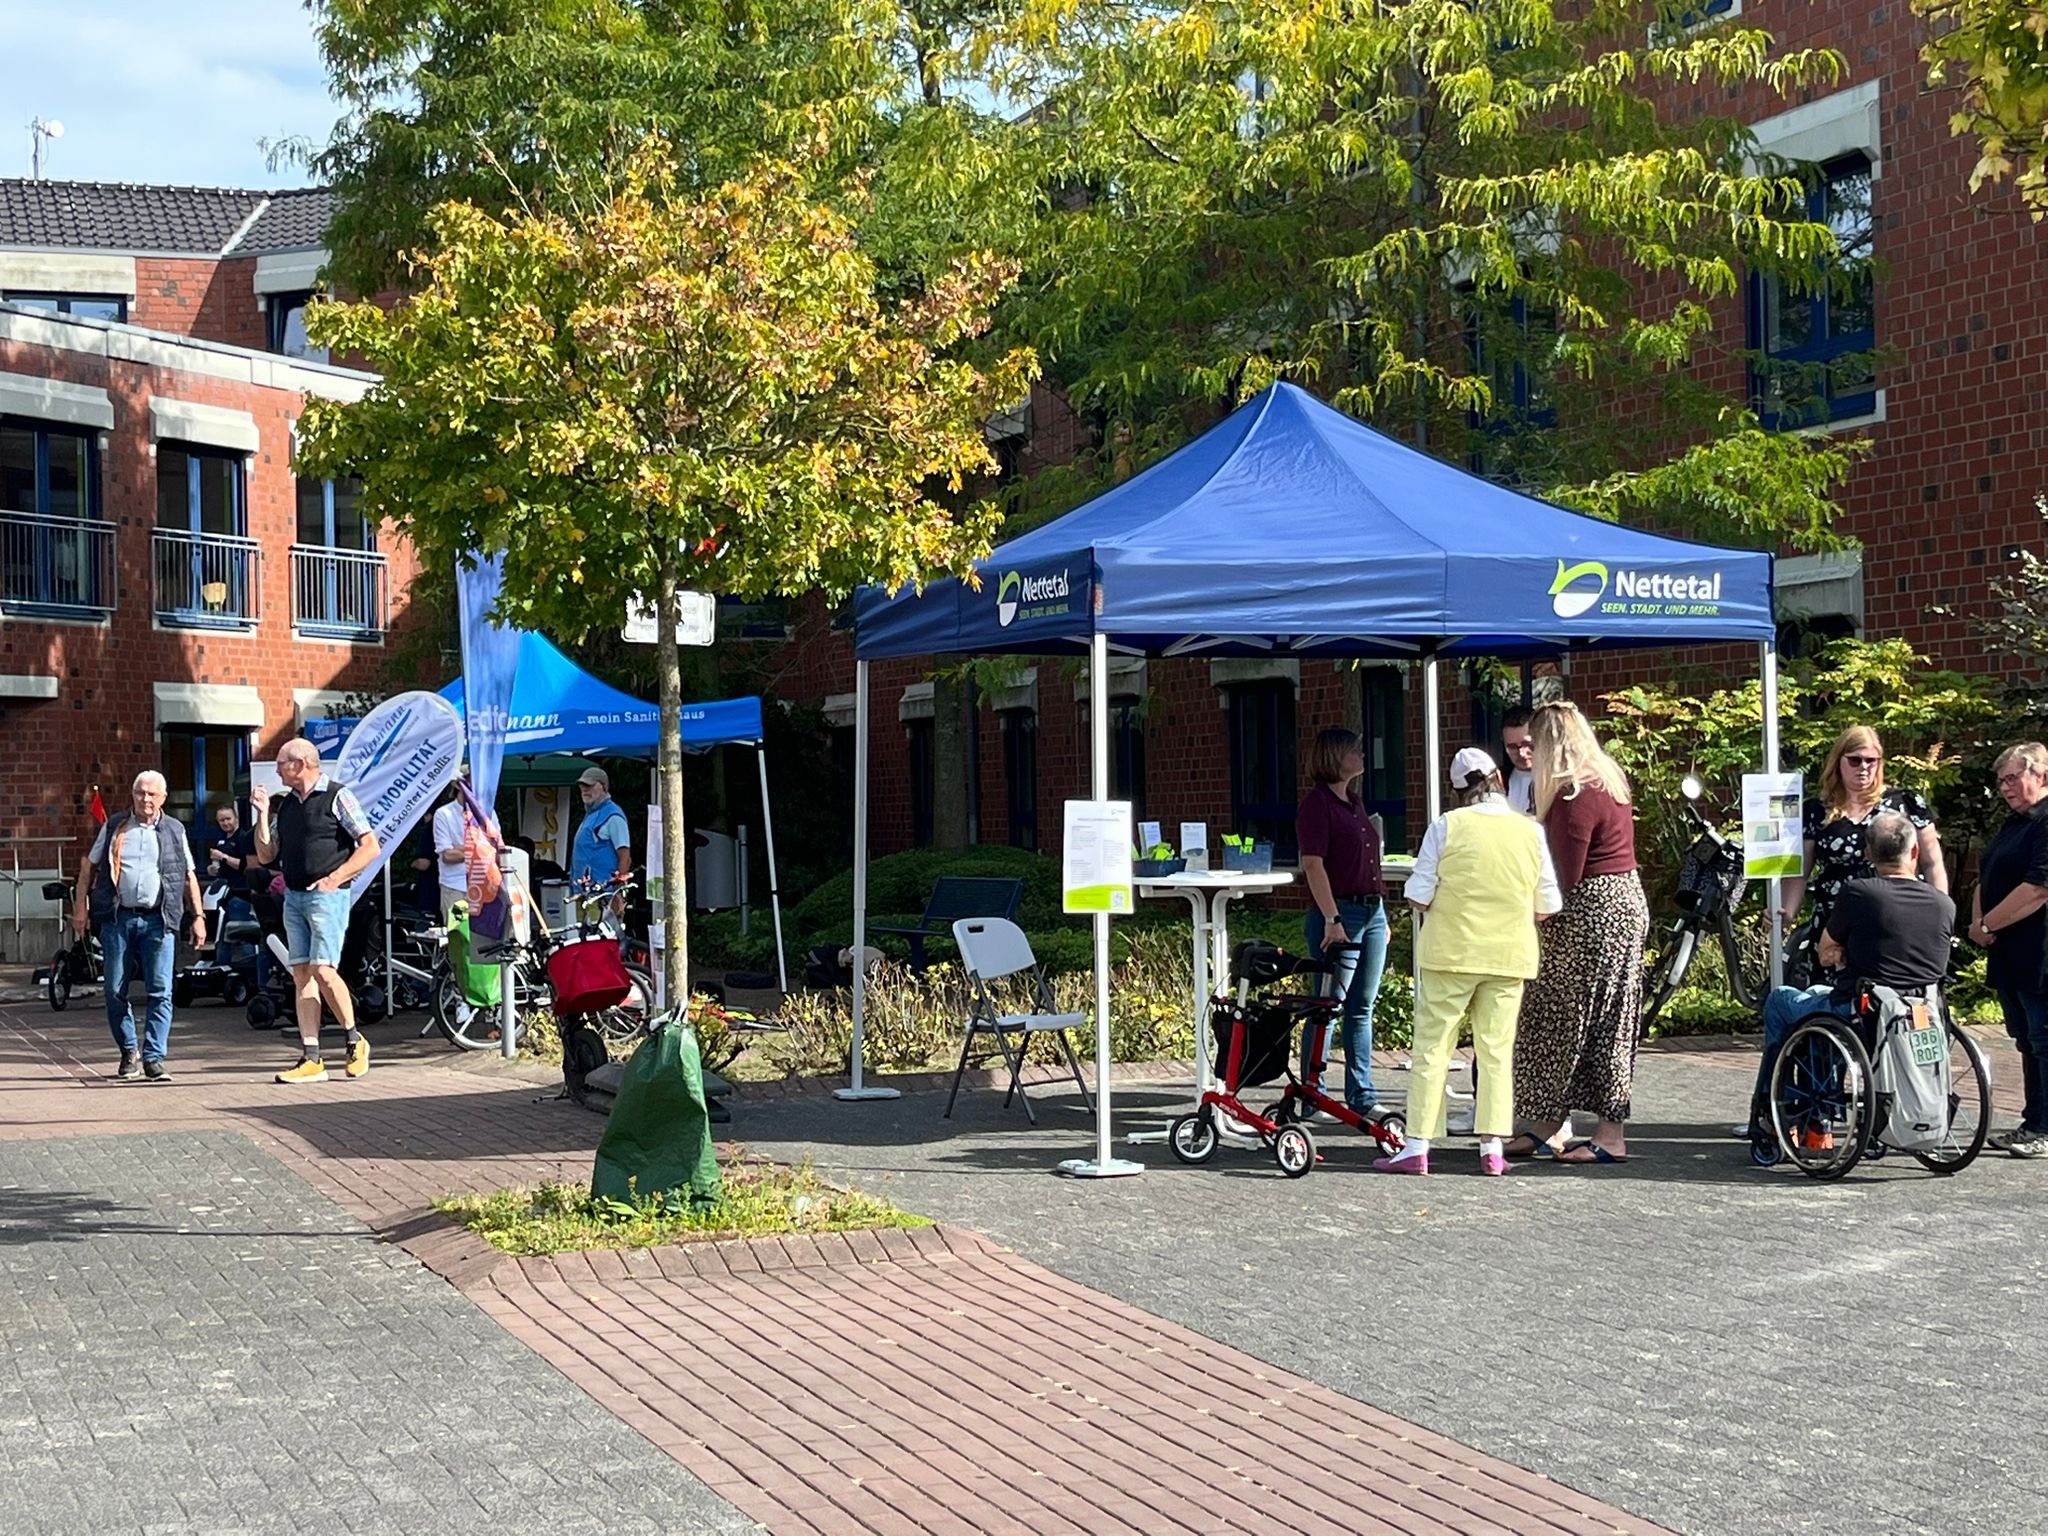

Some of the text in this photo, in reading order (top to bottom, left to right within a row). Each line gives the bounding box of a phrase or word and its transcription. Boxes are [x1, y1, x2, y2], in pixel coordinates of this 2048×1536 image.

[1022, 568, 1069, 602] Nettetal
[1615, 570, 1721, 600] Nettetal
[1601, 602, 1720, 616] SEEN. STADT. UND MEHR.
[378, 738, 438, 812] MOBILITÄT
[1912, 1030, 1937, 1047] 386
[1916, 1045, 1939, 1062] ROF
